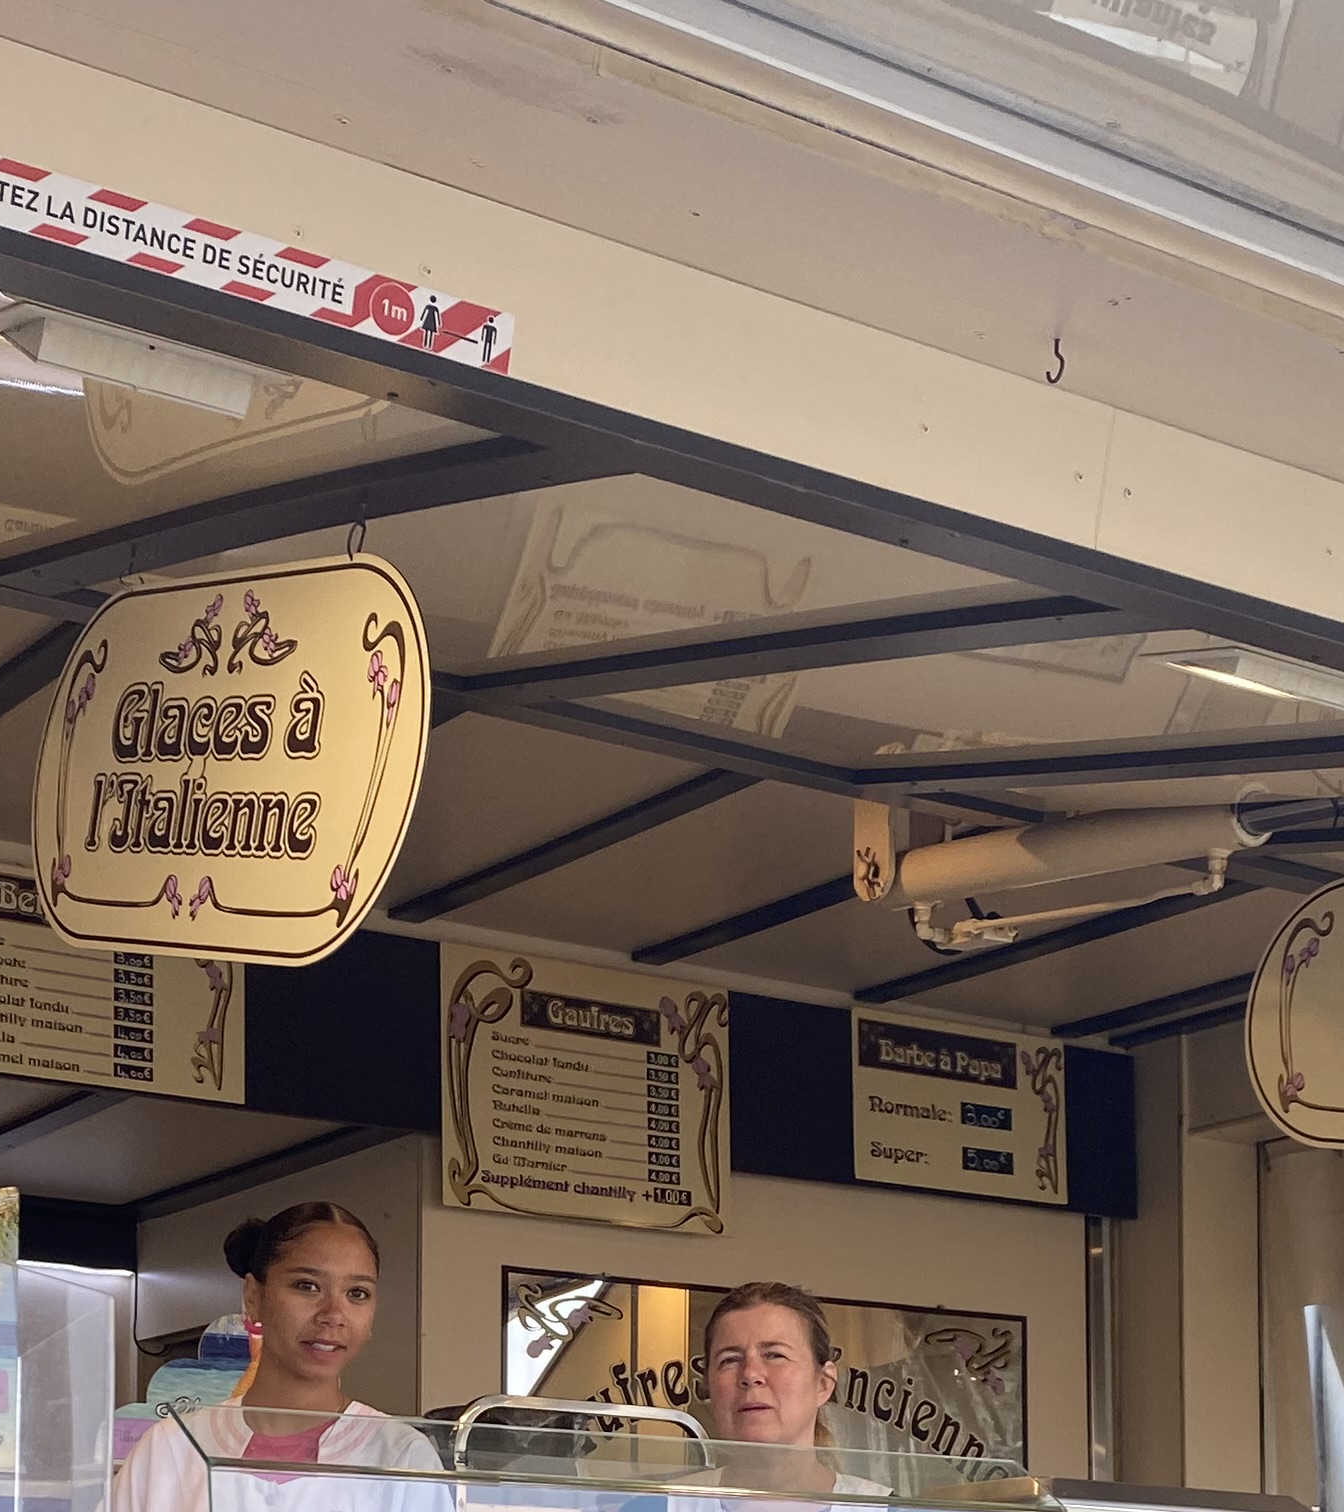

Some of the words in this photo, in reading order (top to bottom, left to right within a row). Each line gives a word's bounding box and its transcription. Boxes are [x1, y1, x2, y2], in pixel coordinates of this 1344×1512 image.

[46, 195, 75, 223] LA
[83, 207, 196, 259] DISTANCE
[202, 243, 231, 271] DE
[237, 253, 345, 304] SÉCURITÉ
[382, 298, 407, 321] 1m
[113, 682, 275, 762] Glaces
[284, 671, 324, 759] à
[85, 772, 321, 860] l'Italienne
[30, 997, 70, 1014] fondu
[31, 1017, 83, 1033] maison
[547, 999, 636, 1036] Gaufres
[491, 1031, 530, 1045] Sucre
[28, 1056, 80, 1073] maison
[491, 1050, 550, 1066] Chocolat
[553, 1056, 590, 1072] fondu
[878, 1039, 936, 1068] Barbe
[940, 1047, 952, 1071] à
[957, 1052, 1002, 1080] Papa
[491, 1067, 552, 1083] Confiture
[491, 1084, 550, 1100] Caramel
[552, 1095, 600, 1108] maison
[868, 1096, 953, 1123] Normale:
[492, 1136, 550, 1154] Chantilly
[555, 1145, 602, 1158] maison
[870, 1142, 930, 1165] Super:
[481, 1170, 570, 1192] Supplément
[573, 1183, 636, 1202] chantilly
